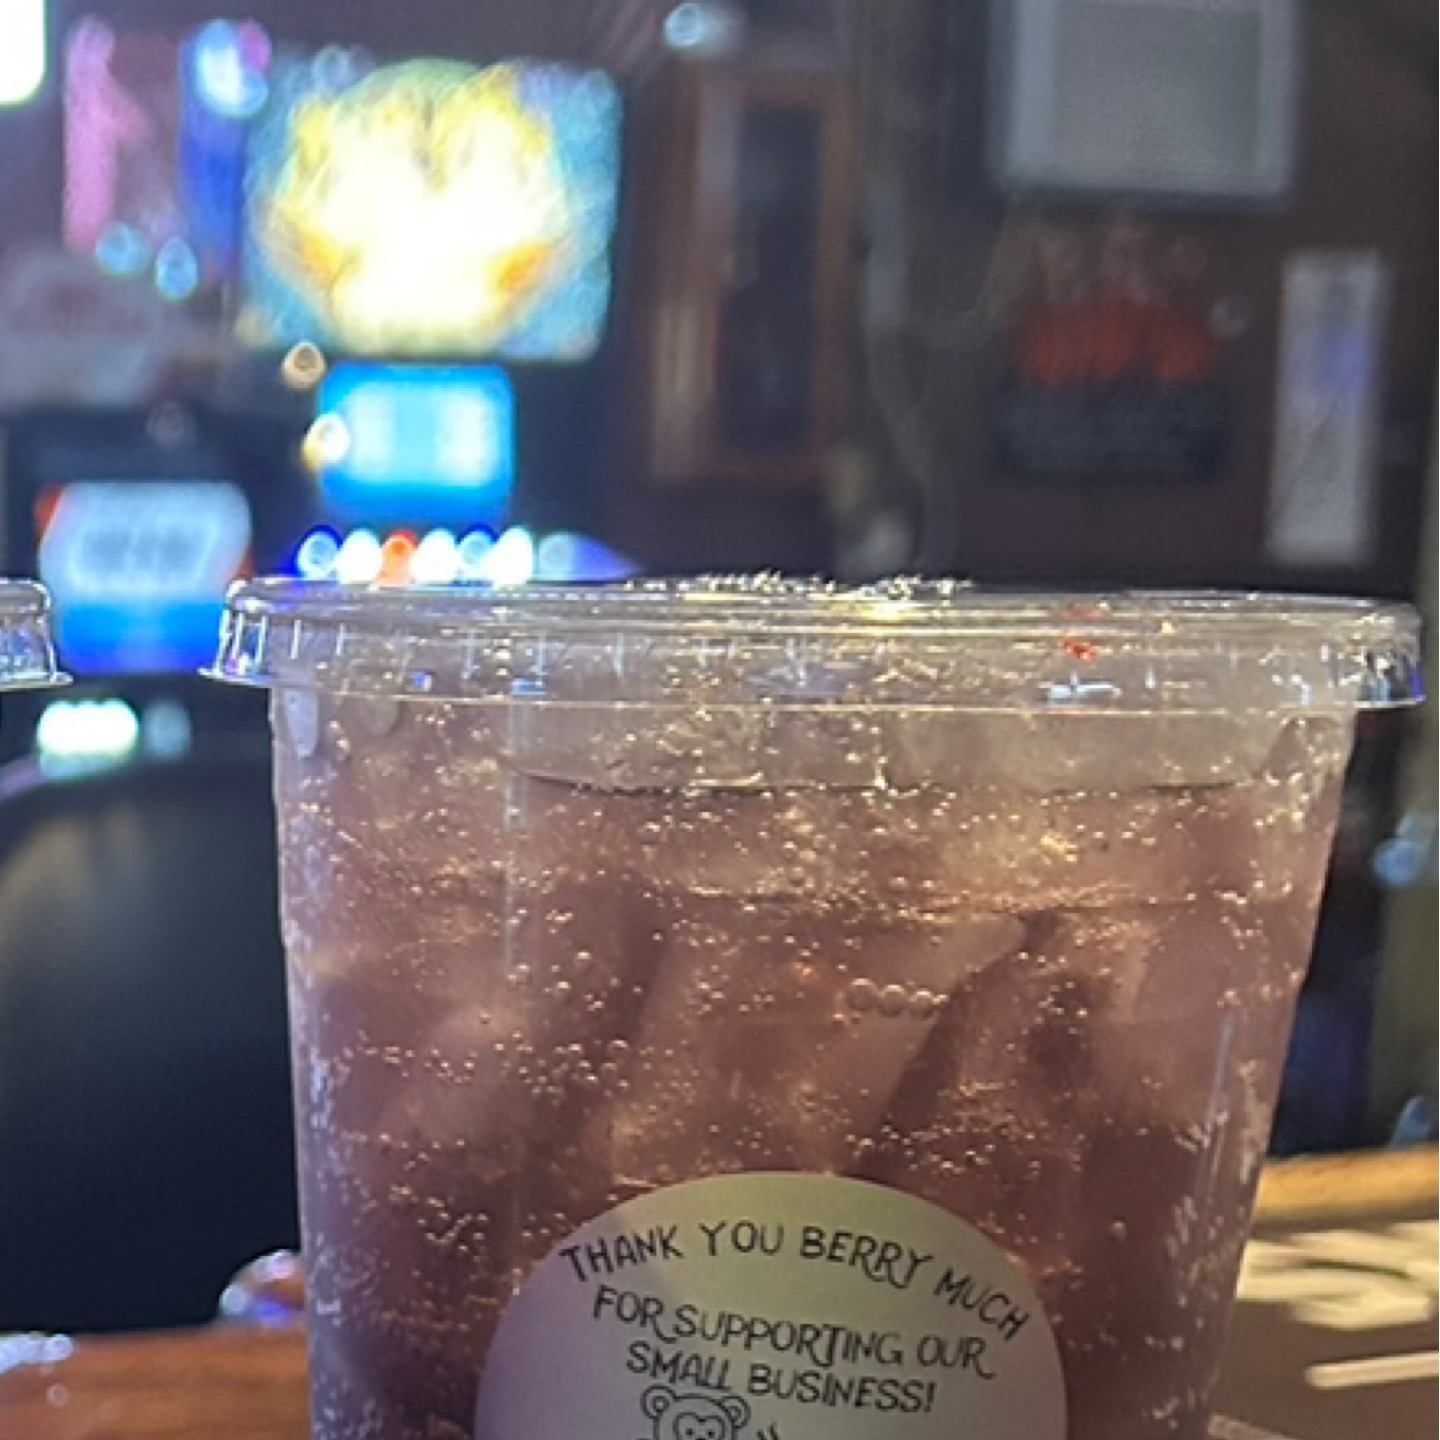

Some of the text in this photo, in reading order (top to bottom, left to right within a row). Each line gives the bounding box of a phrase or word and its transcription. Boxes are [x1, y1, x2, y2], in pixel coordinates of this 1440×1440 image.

[560, 1220, 1030, 1342] THANK YOU BERRY MUCH
[593, 1284, 996, 1380] FOR SUPPORTING OUR
[626, 1339, 938, 1414] SMALL BUSINESS!
